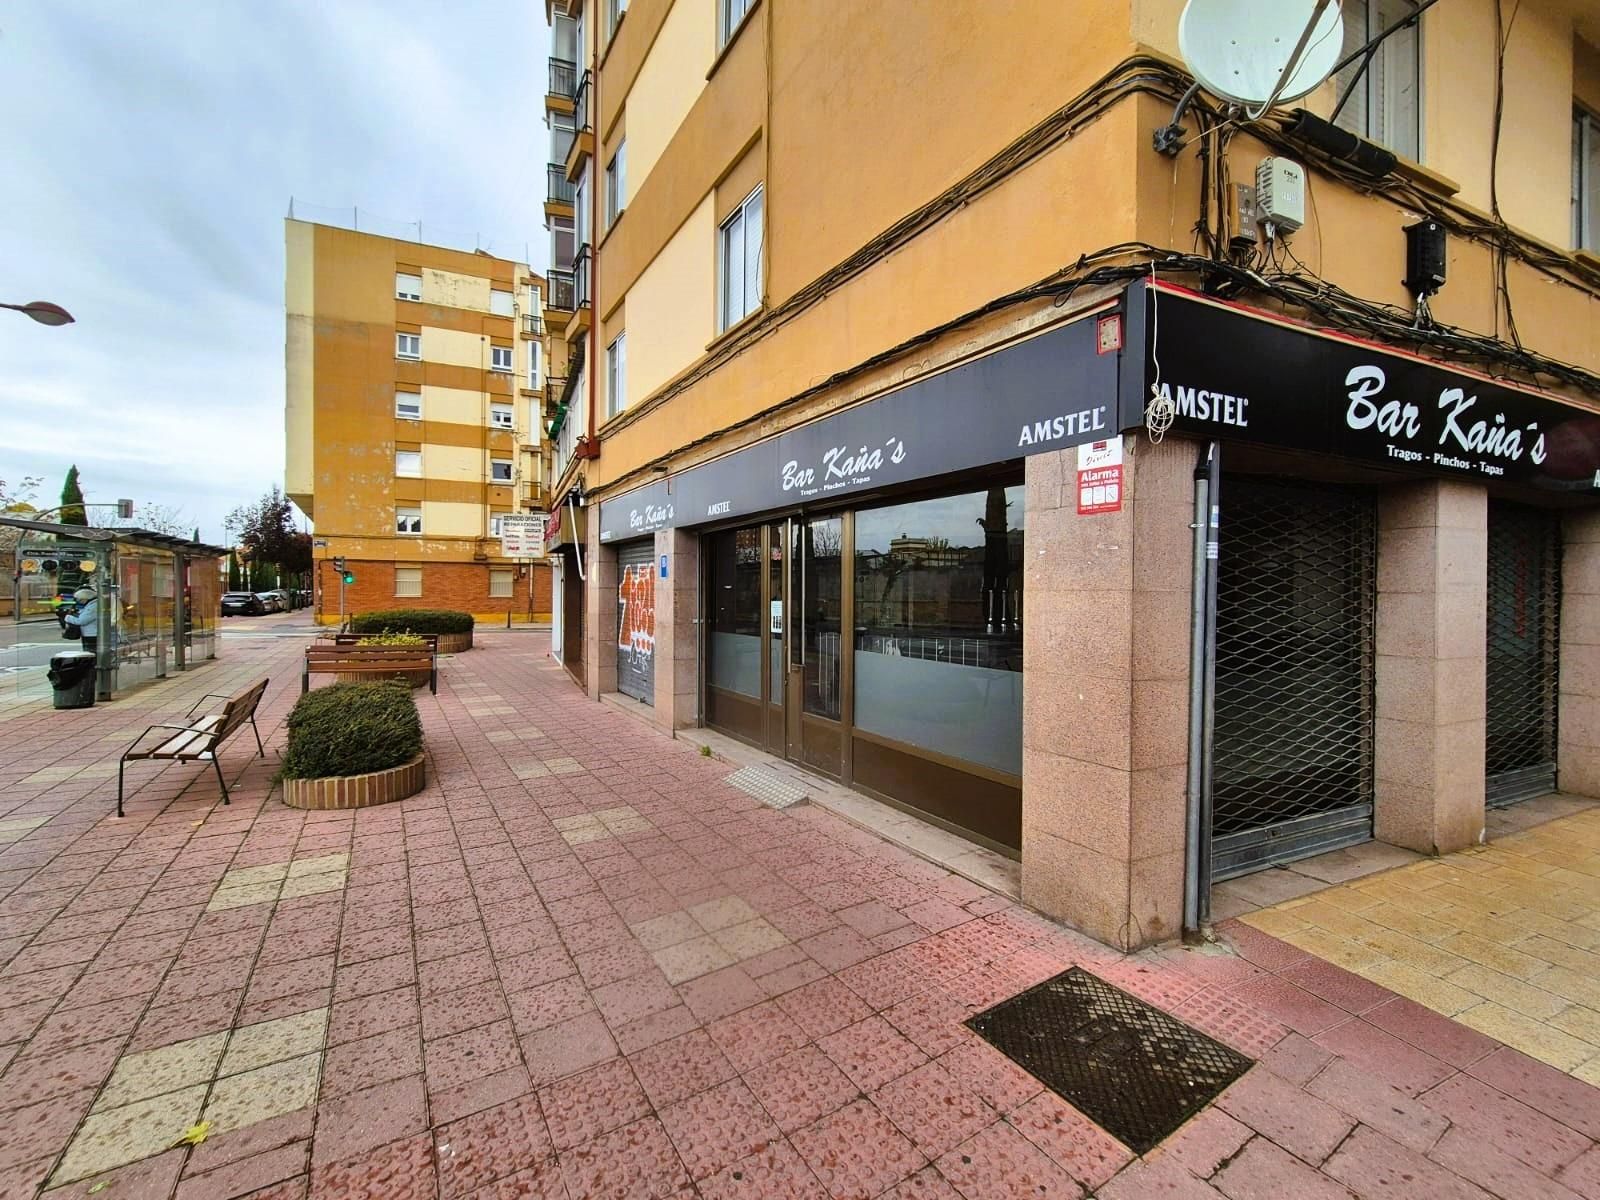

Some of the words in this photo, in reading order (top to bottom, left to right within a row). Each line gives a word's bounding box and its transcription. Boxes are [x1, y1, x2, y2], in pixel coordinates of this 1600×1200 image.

[1345, 365, 1421, 439] Bar
[1018, 406, 1106, 447] AMSTEL
[782, 460, 815, 491] Bar
[1081, 469, 1119, 482] Alarma
[1387, 444, 1423, 462] Tragos
[1433, 453, 1471, 470] Pinchos
[1479, 461, 1504, 476] Tapas
